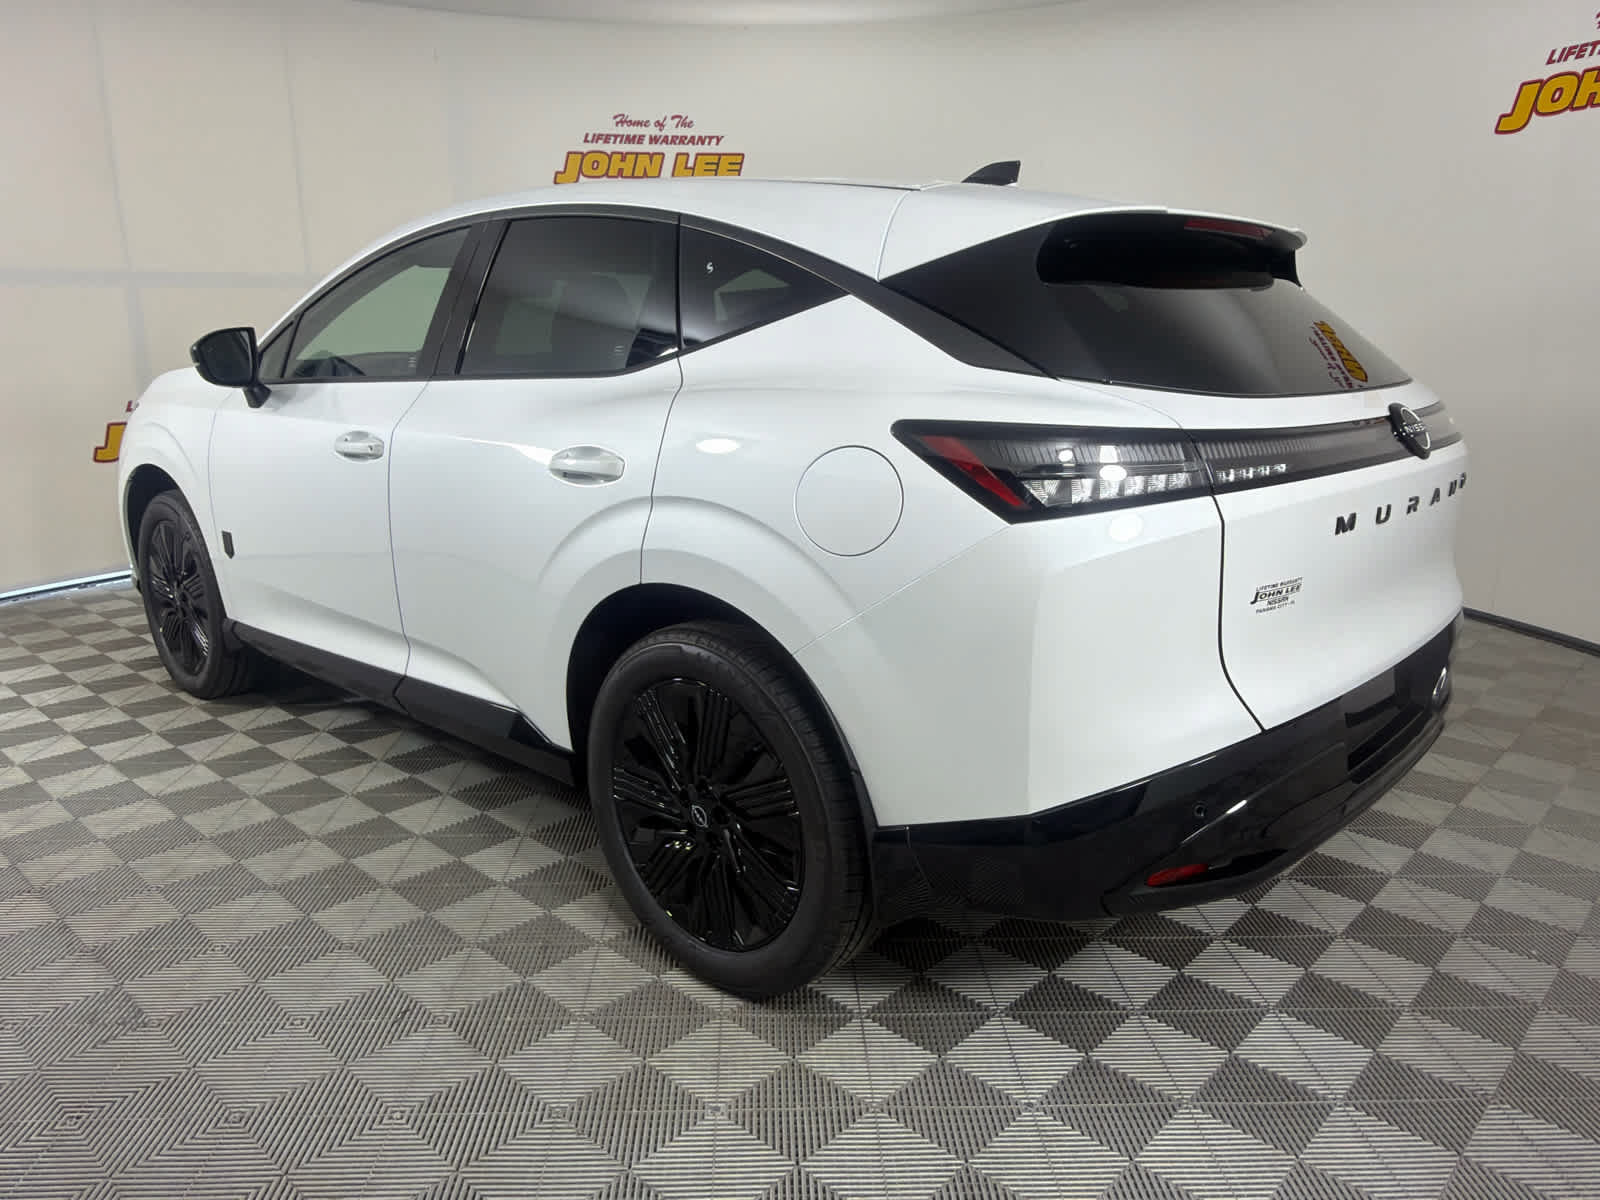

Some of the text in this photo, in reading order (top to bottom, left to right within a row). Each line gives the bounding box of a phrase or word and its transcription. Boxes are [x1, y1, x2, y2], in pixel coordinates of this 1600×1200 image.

[1546, 39, 1600, 65] LIFET
[613, 113, 694, 132] Home of The
[583, 133, 725, 146] LIFETIME WARRANTY
[553, 151, 745, 185] JOHN LEE
[1250, 590, 1283, 604] JOHN
